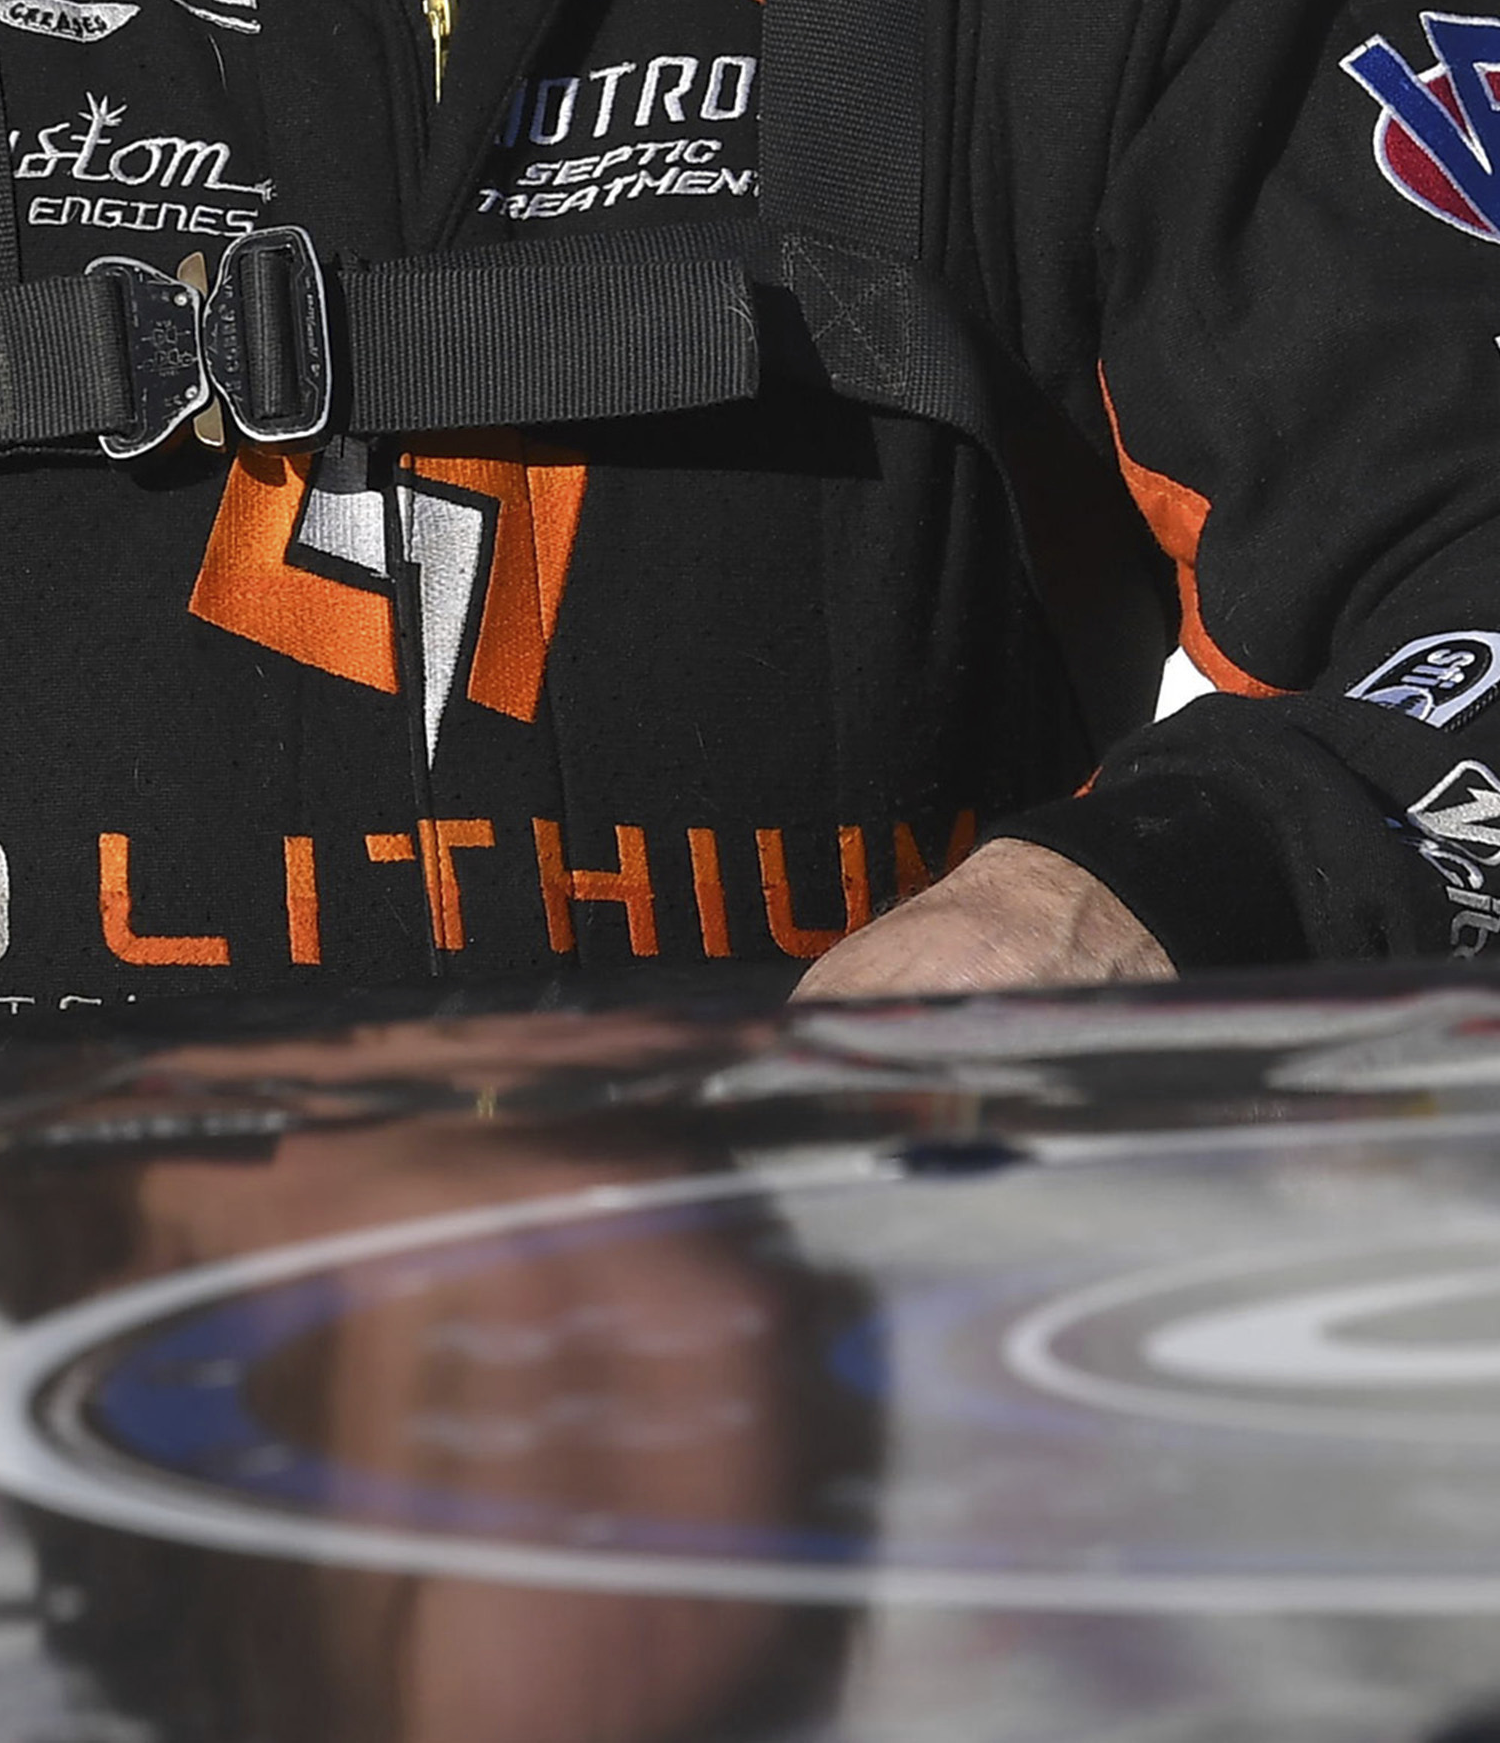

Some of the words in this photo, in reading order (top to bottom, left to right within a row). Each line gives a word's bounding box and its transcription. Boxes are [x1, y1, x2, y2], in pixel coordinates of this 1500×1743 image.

[494, 56, 760, 148] OTRO
[9, 92, 277, 204] stom
[517, 139, 722, 186] SEPTIC
[28, 196, 259, 237] ENGINES
[477, 166, 760, 221] TREATMEN
